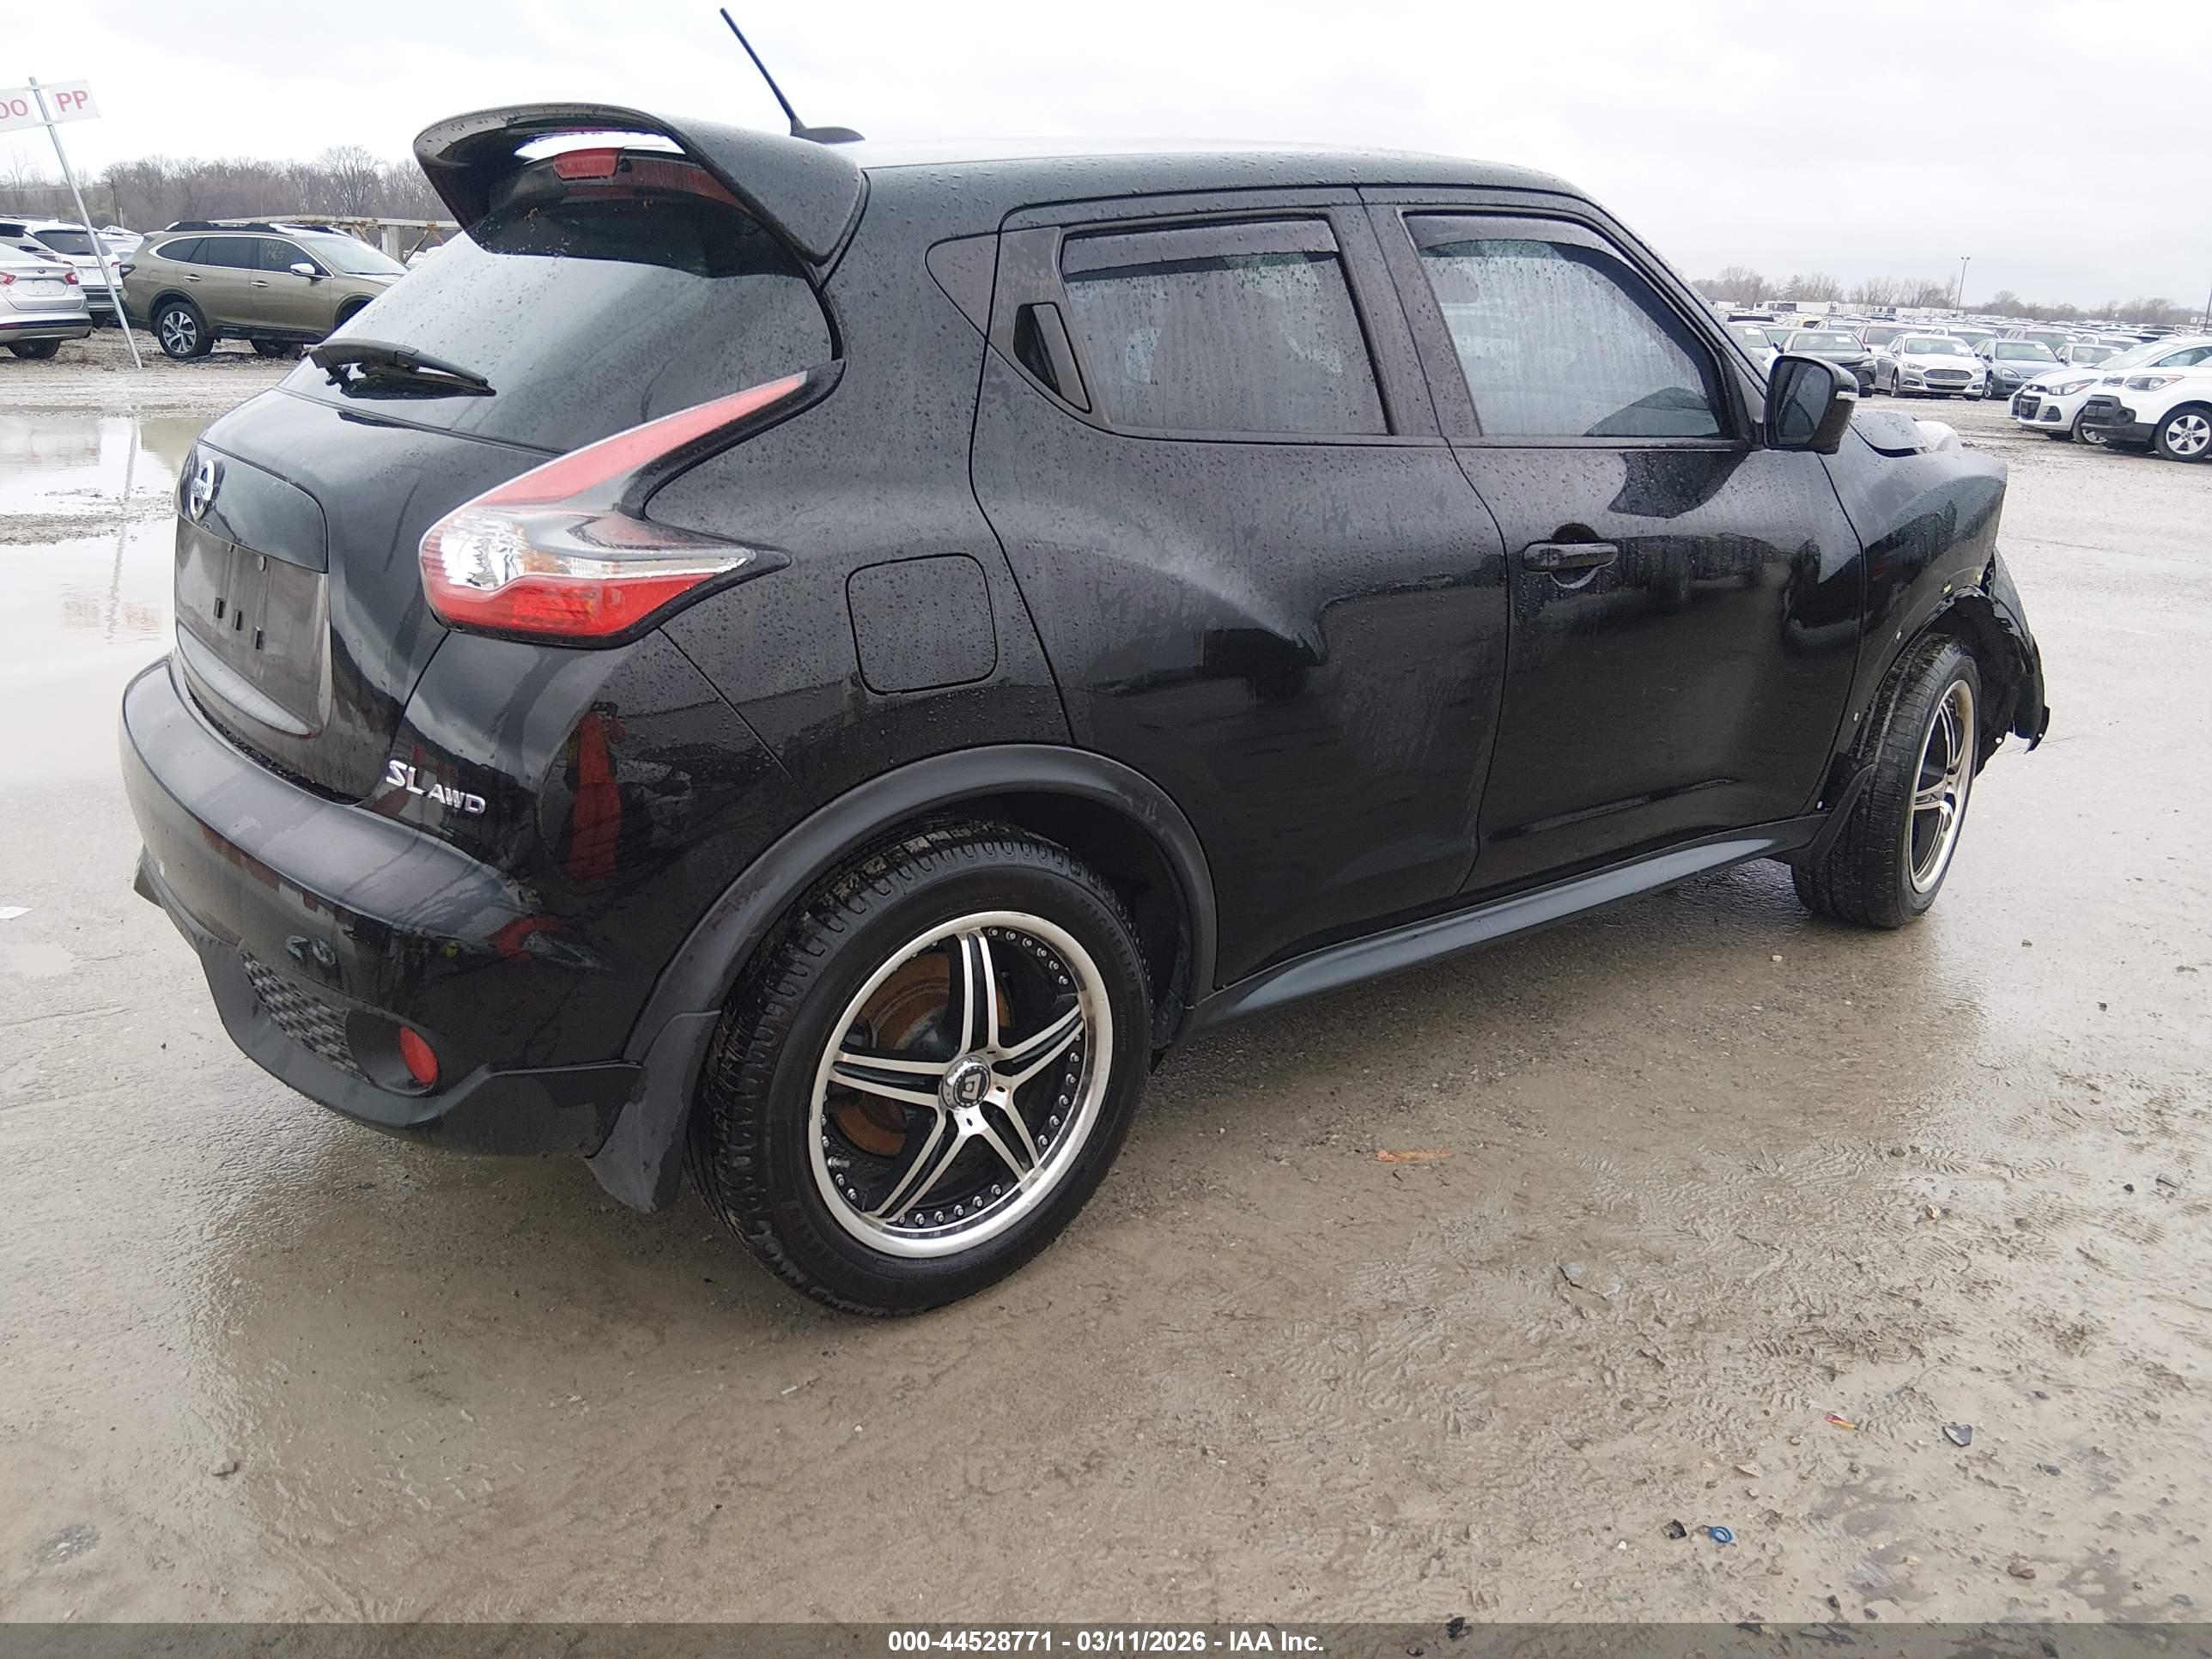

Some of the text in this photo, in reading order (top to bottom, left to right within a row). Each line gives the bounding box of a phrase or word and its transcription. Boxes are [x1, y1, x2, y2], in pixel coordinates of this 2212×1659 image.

[56, 90, 88, 112] PP
[386, 759, 486, 814] SL AWD
